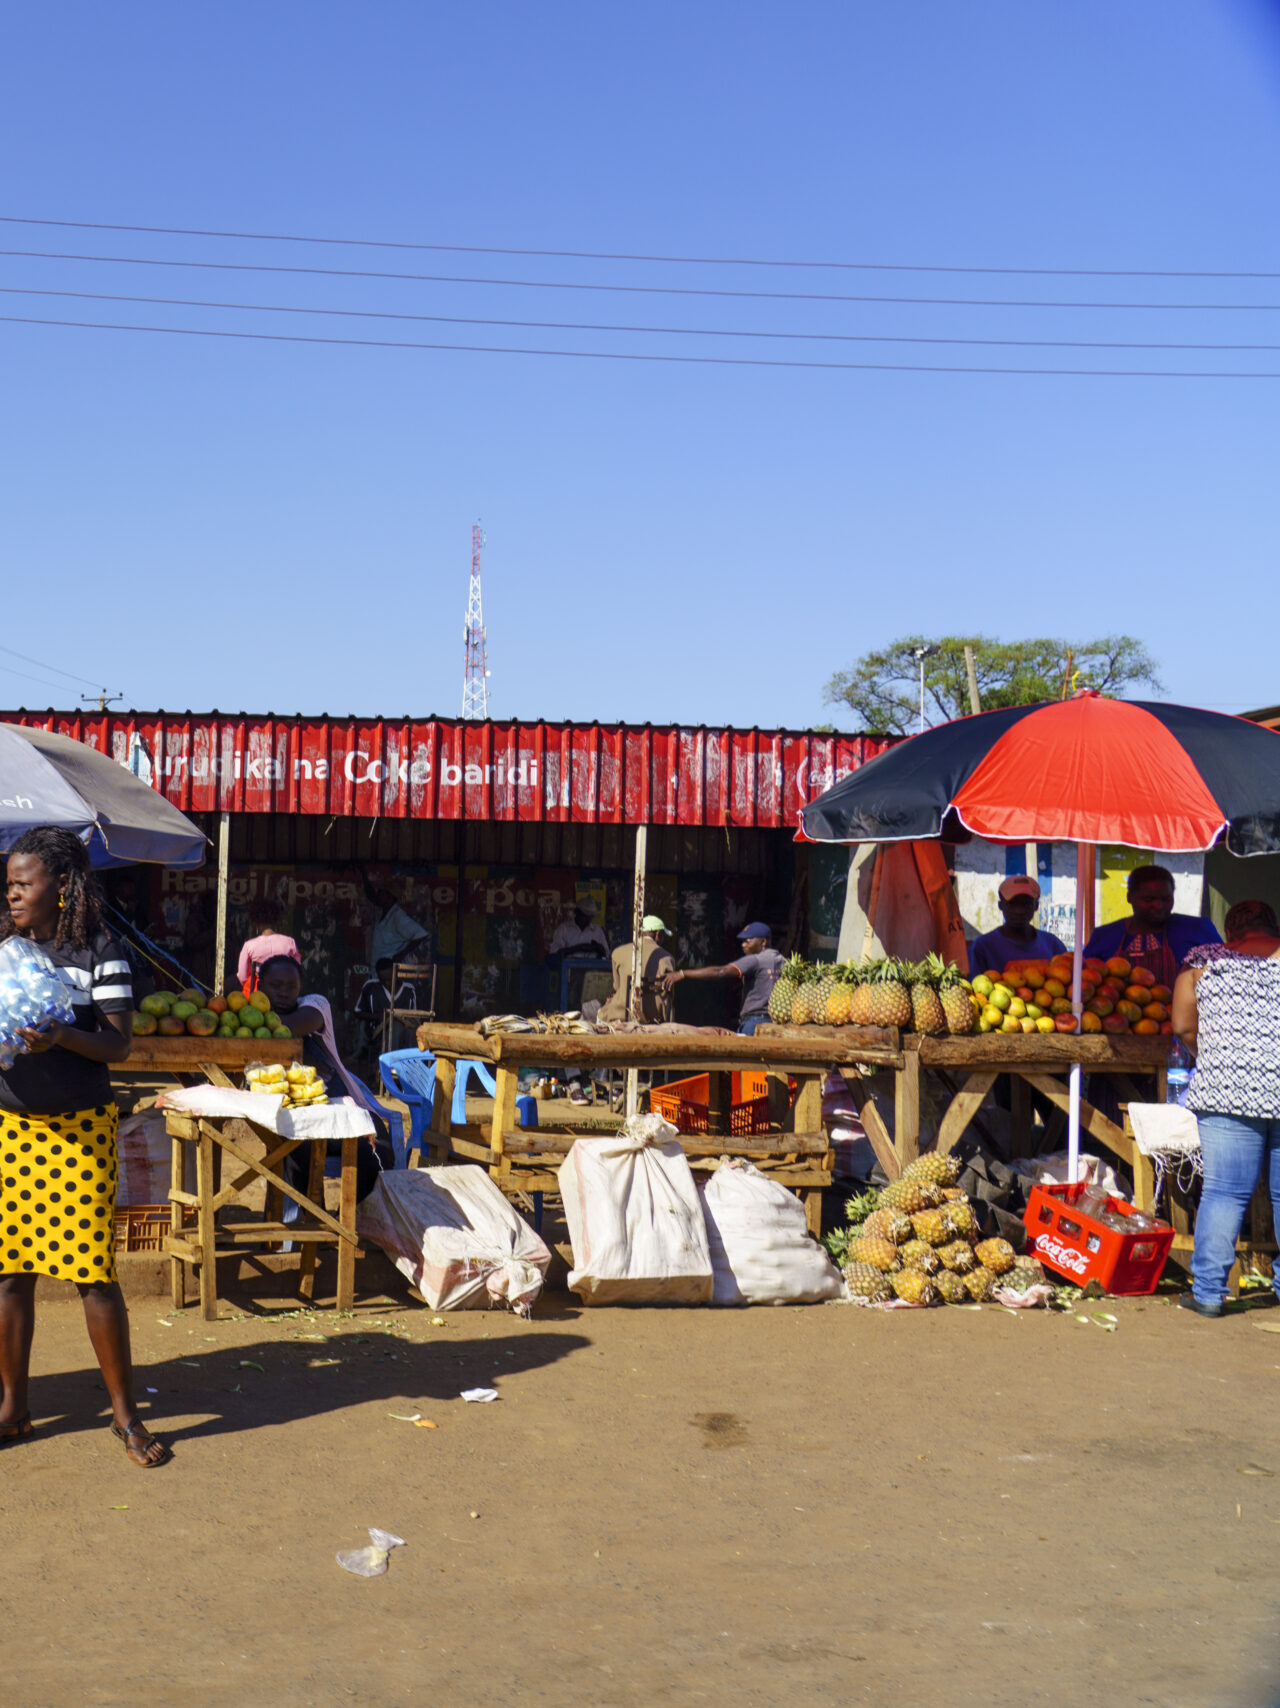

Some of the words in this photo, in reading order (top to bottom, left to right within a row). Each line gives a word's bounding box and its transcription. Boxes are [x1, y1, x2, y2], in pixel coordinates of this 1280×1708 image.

[156, 751, 284, 780] urudika
[294, 757, 330, 780] na
[345, 751, 431, 784] Coke
[440, 758, 538, 786] baridi
[1035, 1233, 1091, 1275] Coca-Cola
